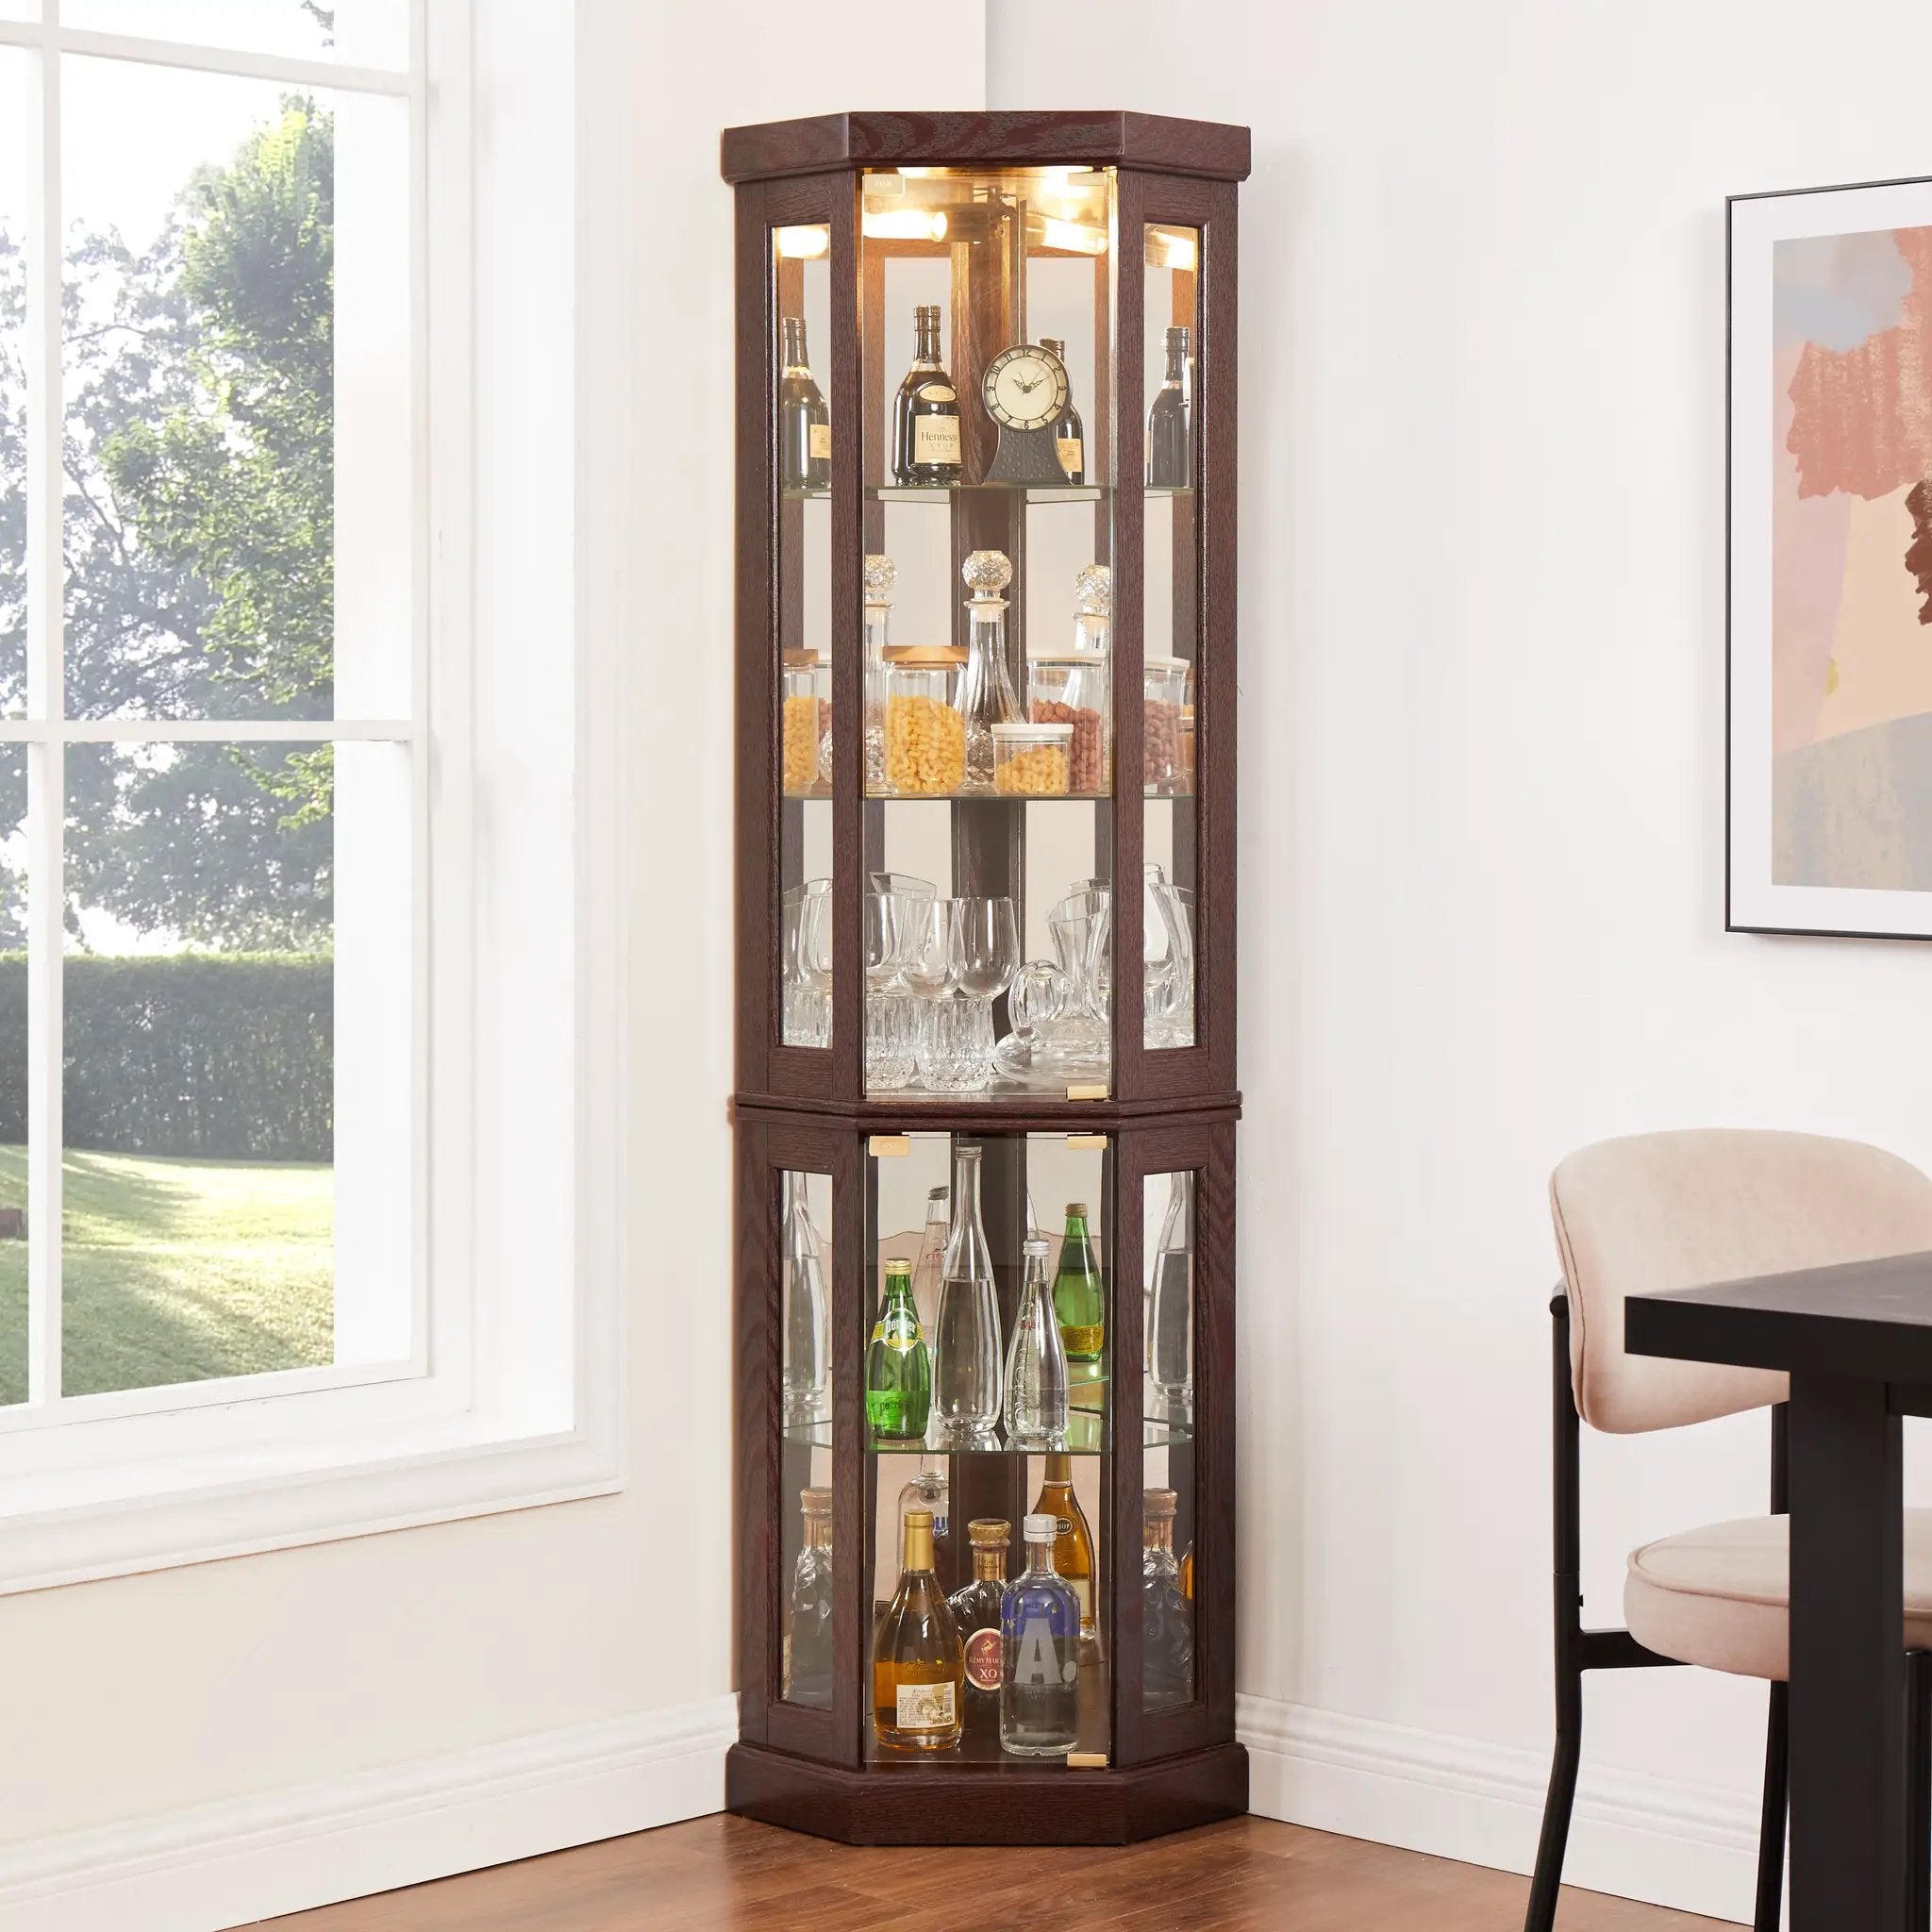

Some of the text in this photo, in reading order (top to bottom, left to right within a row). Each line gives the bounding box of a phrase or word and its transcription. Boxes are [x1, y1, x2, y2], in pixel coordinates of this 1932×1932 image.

[1023, 348, 1032, 358] 12
[991, 365, 1001, 375] 10
[991, 403, 1000, 411] 8
[1041, 415, 1049, 425] 5
[1024, 421, 1030, 430] 6
[921, 431, 958, 442] Hennessy
[885, 1317, 916, 1334] perier
[979, 1668, 997, 1679] XO
